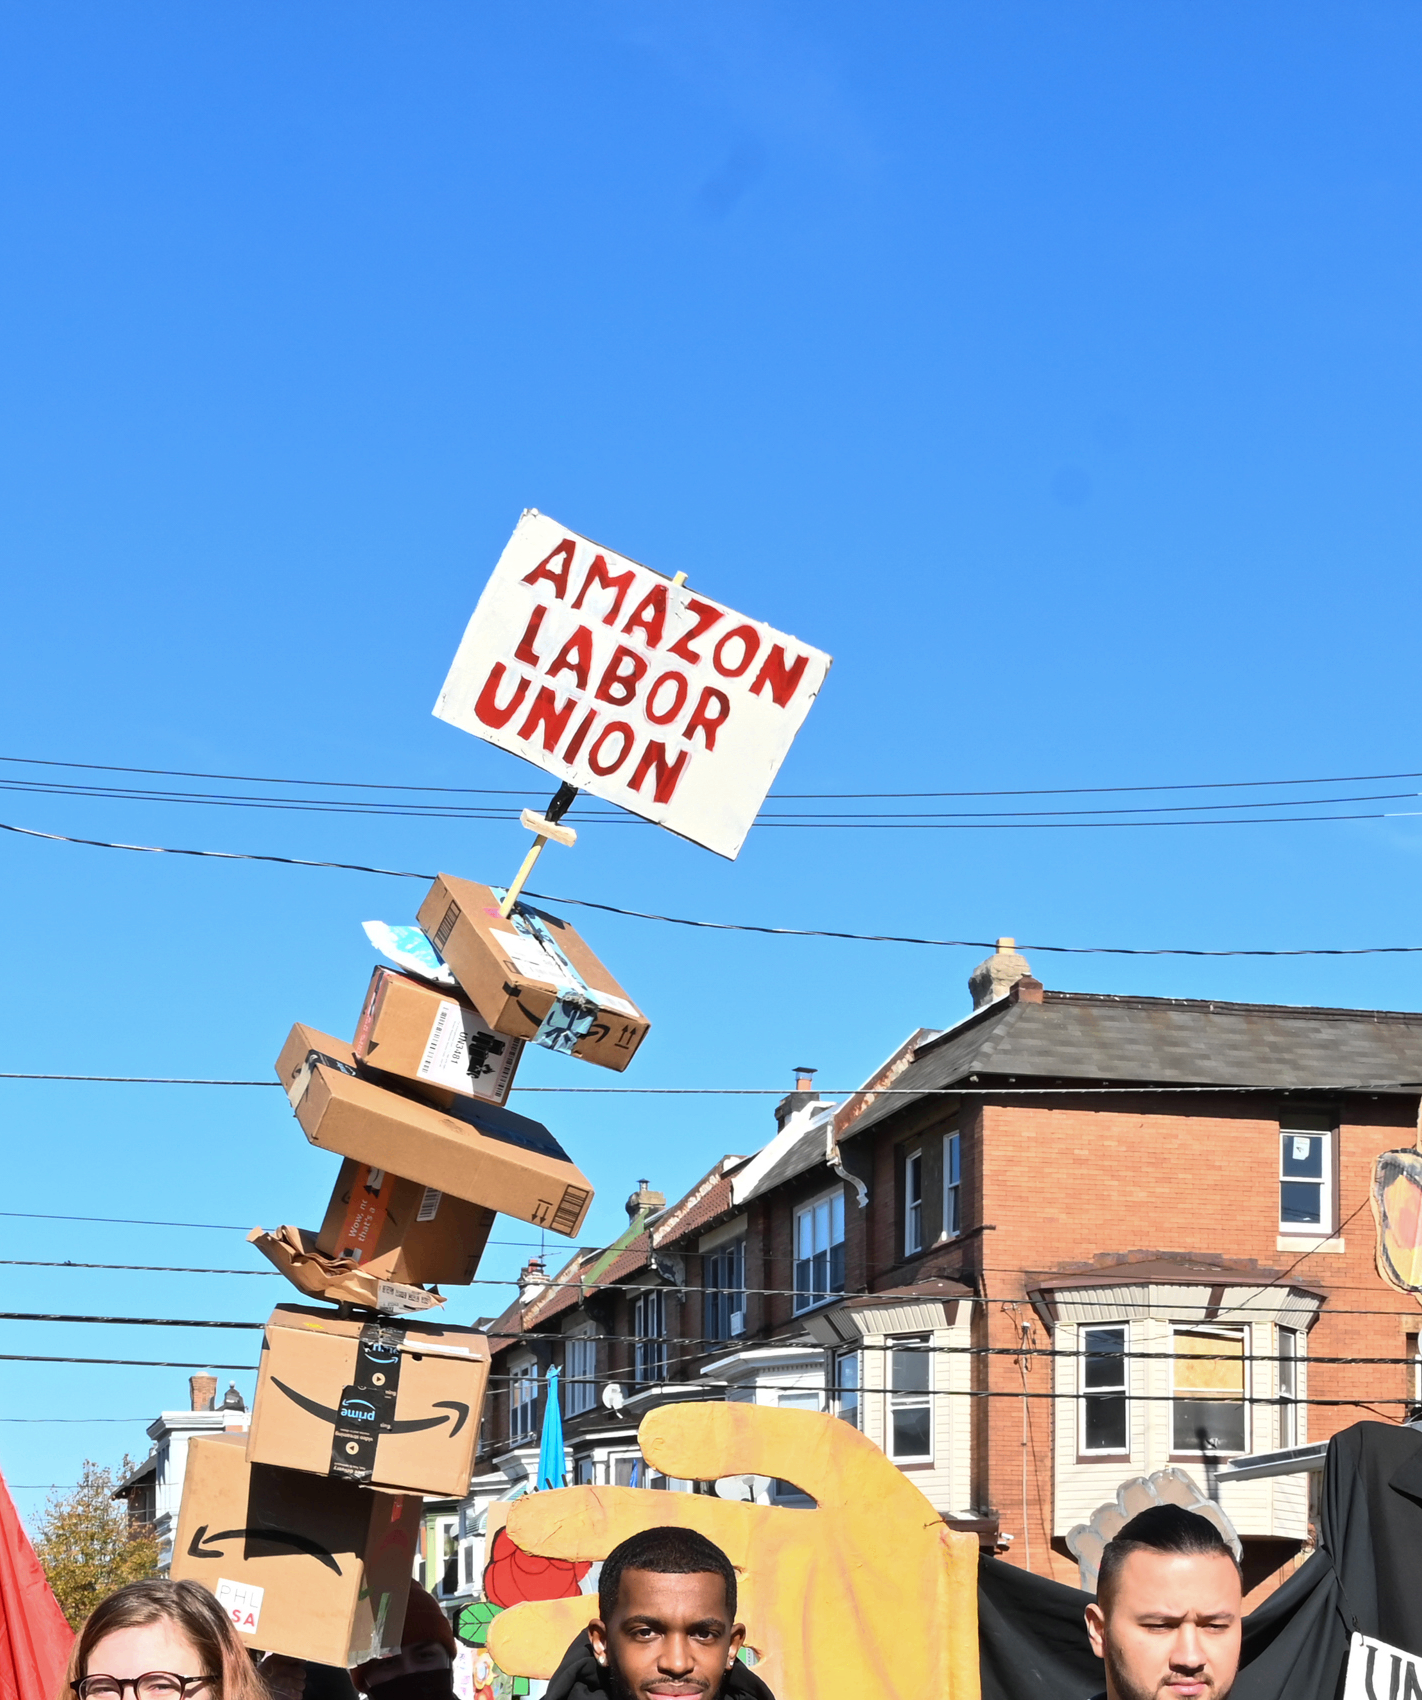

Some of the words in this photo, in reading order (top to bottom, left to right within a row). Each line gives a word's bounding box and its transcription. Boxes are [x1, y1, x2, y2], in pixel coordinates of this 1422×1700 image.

[521, 538, 810, 709] AMAZON
[514, 604, 731, 753] LABOR
[474, 661, 692, 805] UNION
[451, 1032, 468, 1065] UN3481
[348, 1212, 364, 1238] Wow,
[358, 1214, 374, 1242] that's
[340, 1407, 376, 1422] prime
[219, 1584, 258, 1608] PHL
[231, 1609, 255, 1627] SA
